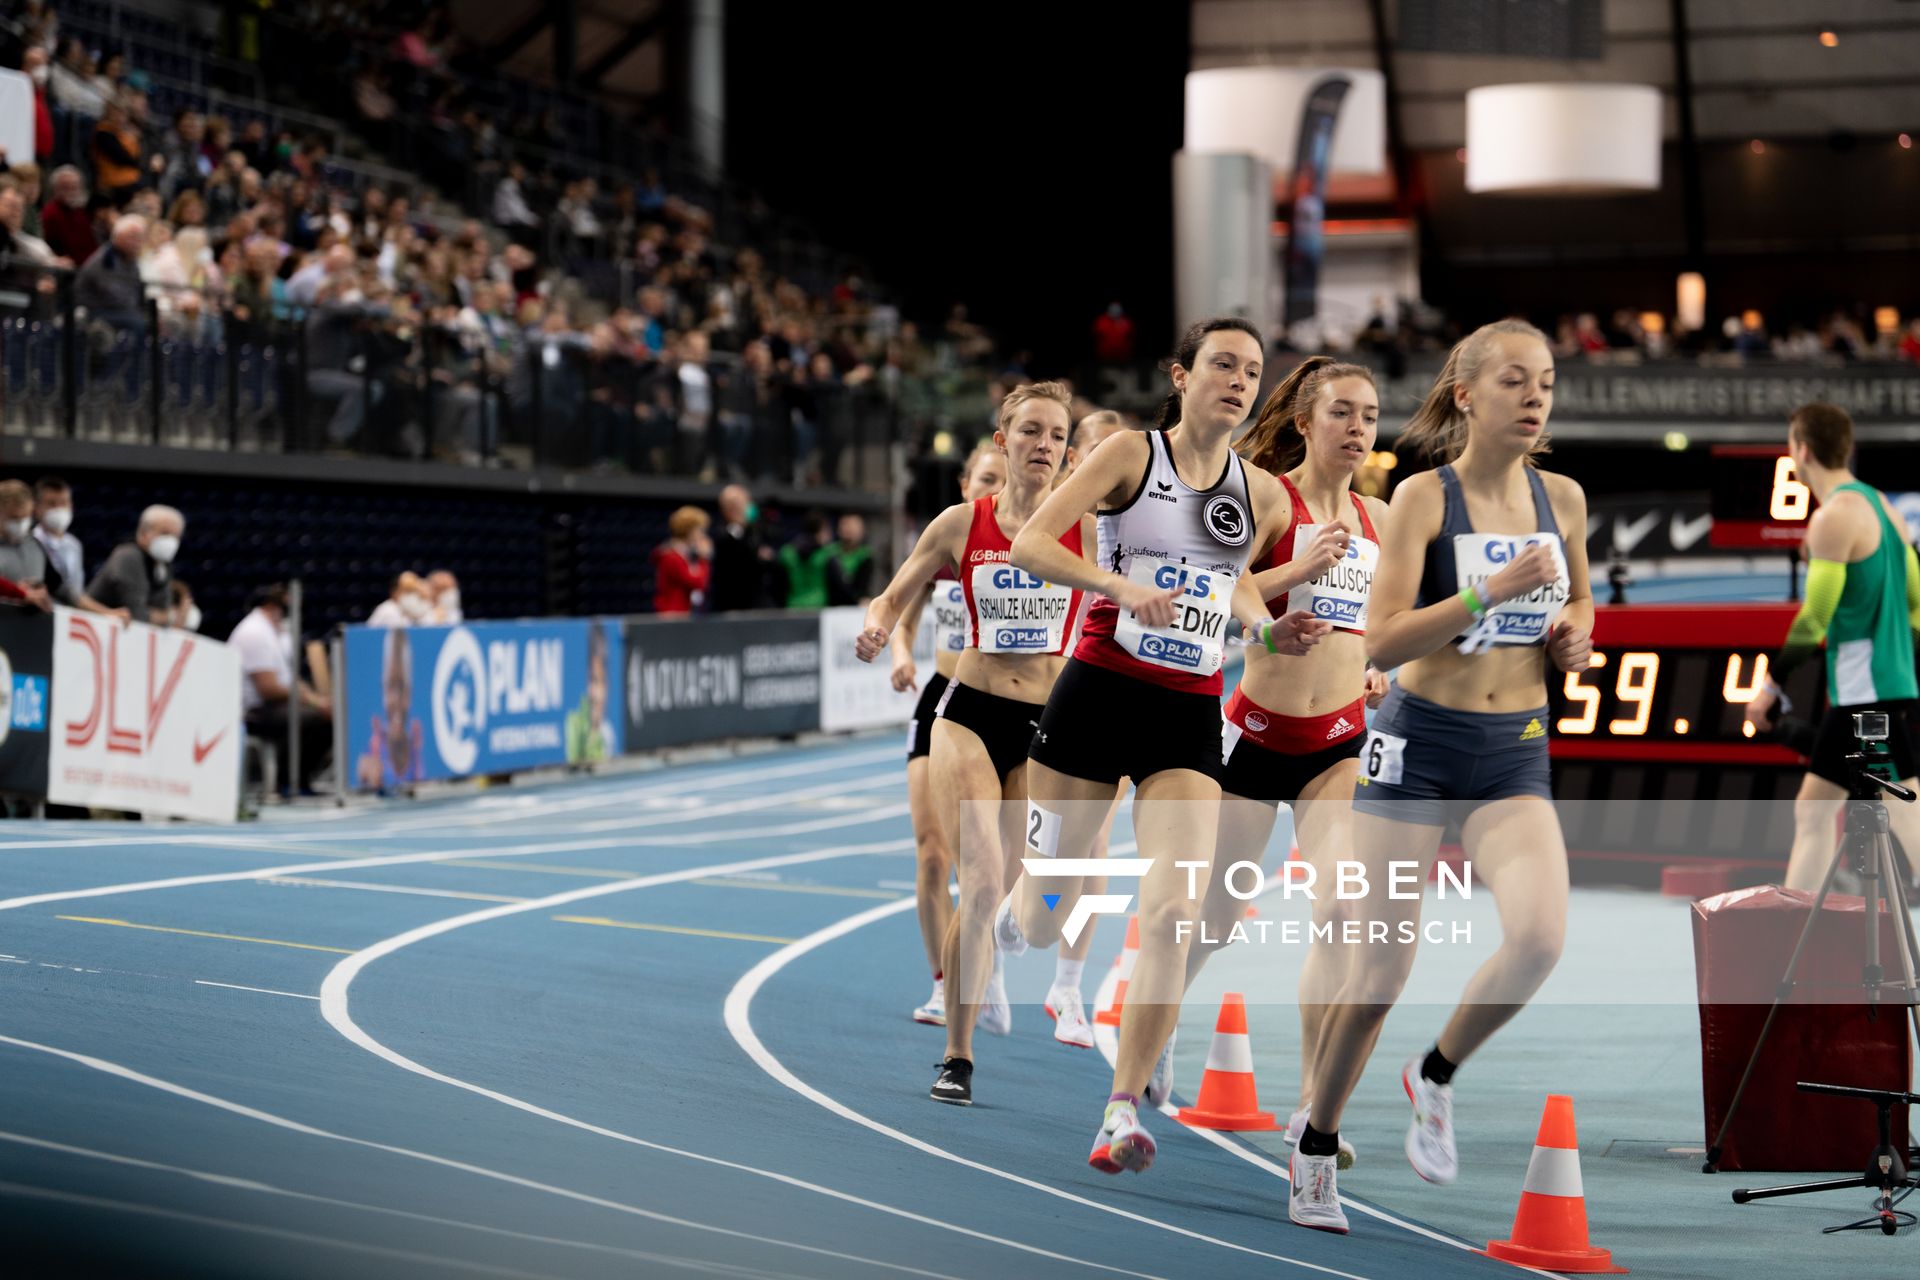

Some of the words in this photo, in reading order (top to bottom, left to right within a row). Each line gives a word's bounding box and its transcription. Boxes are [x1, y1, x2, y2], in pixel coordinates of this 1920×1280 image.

[1148, 491, 1177, 503] erima
[1770, 456, 1810, 520] 6
[980, 598, 1018, 620] SCHULZE
[1021, 598, 1067, 620] KALTHOFF
[1017, 632, 1047, 642] PLAN
[1166, 643, 1201, 660] PLAN
[488, 638, 564, 715] PLAN
[643, 655, 741, 712] NOVAFON
[1326, 723, 1356, 740] adidas
[1367, 737, 1385, 778] 6
[1028, 808, 1043, 849] 2
